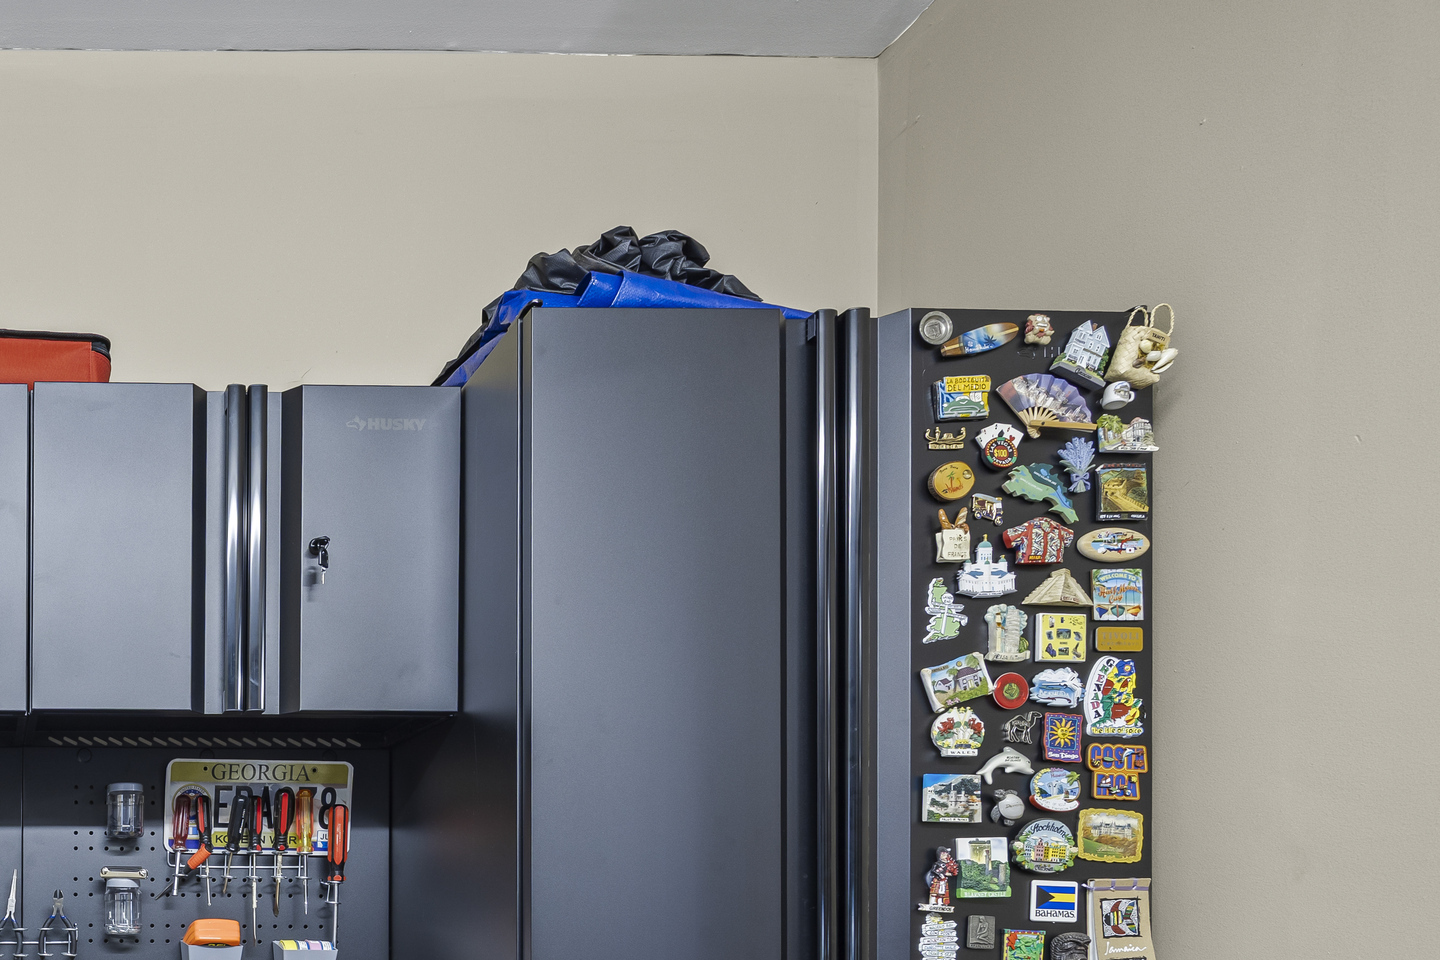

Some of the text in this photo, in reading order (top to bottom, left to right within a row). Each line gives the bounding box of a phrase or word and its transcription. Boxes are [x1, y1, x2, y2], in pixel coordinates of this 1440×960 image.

[947, 383, 986, 392] DEL MEDIO
[367, 418, 427, 431] HUSKY
[996, 440, 1013, 453] VEGAS
[994, 449, 1008, 458] $100
[992, 456, 1012, 465] NEVADA
[1100, 573, 1127, 582] WELCOME
[1102, 631, 1140, 640] TIVOLI
[1090, 658, 1115, 719] GRENADA
[1125, 727, 1143, 736] spice
[1059, 752, 1079, 760] Diego
[1090, 745, 1145, 771] COSTA
[211, 763, 311, 782] GEORGIA
[1030, 822, 1067, 838] Stockholm
[1104, 941, 1147, 956] Jamaica
